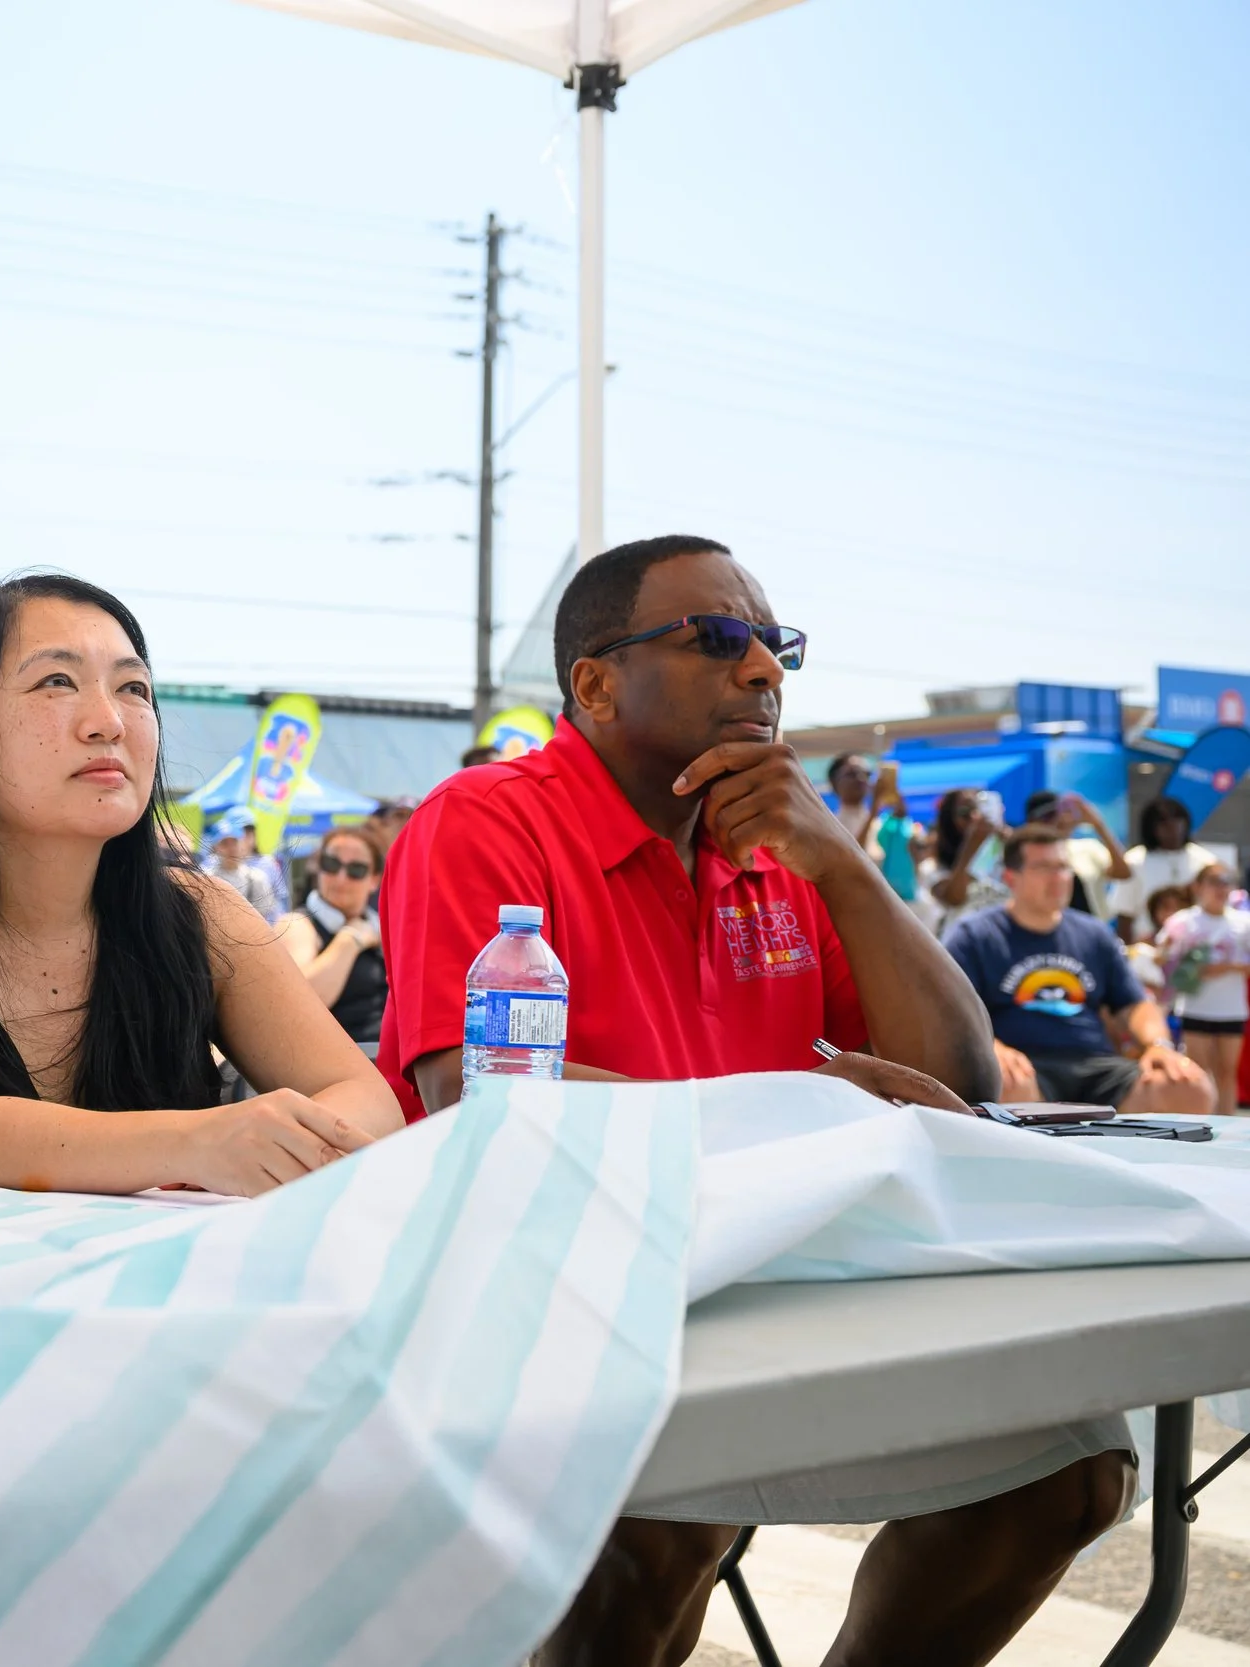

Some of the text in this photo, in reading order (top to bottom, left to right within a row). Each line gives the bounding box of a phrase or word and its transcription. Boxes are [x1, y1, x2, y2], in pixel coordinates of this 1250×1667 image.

[719, 911, 798, 937] WEXORD
[734, 963, 762, 977] TASTE
[769, 955, 817, 973] LAWRENCE
